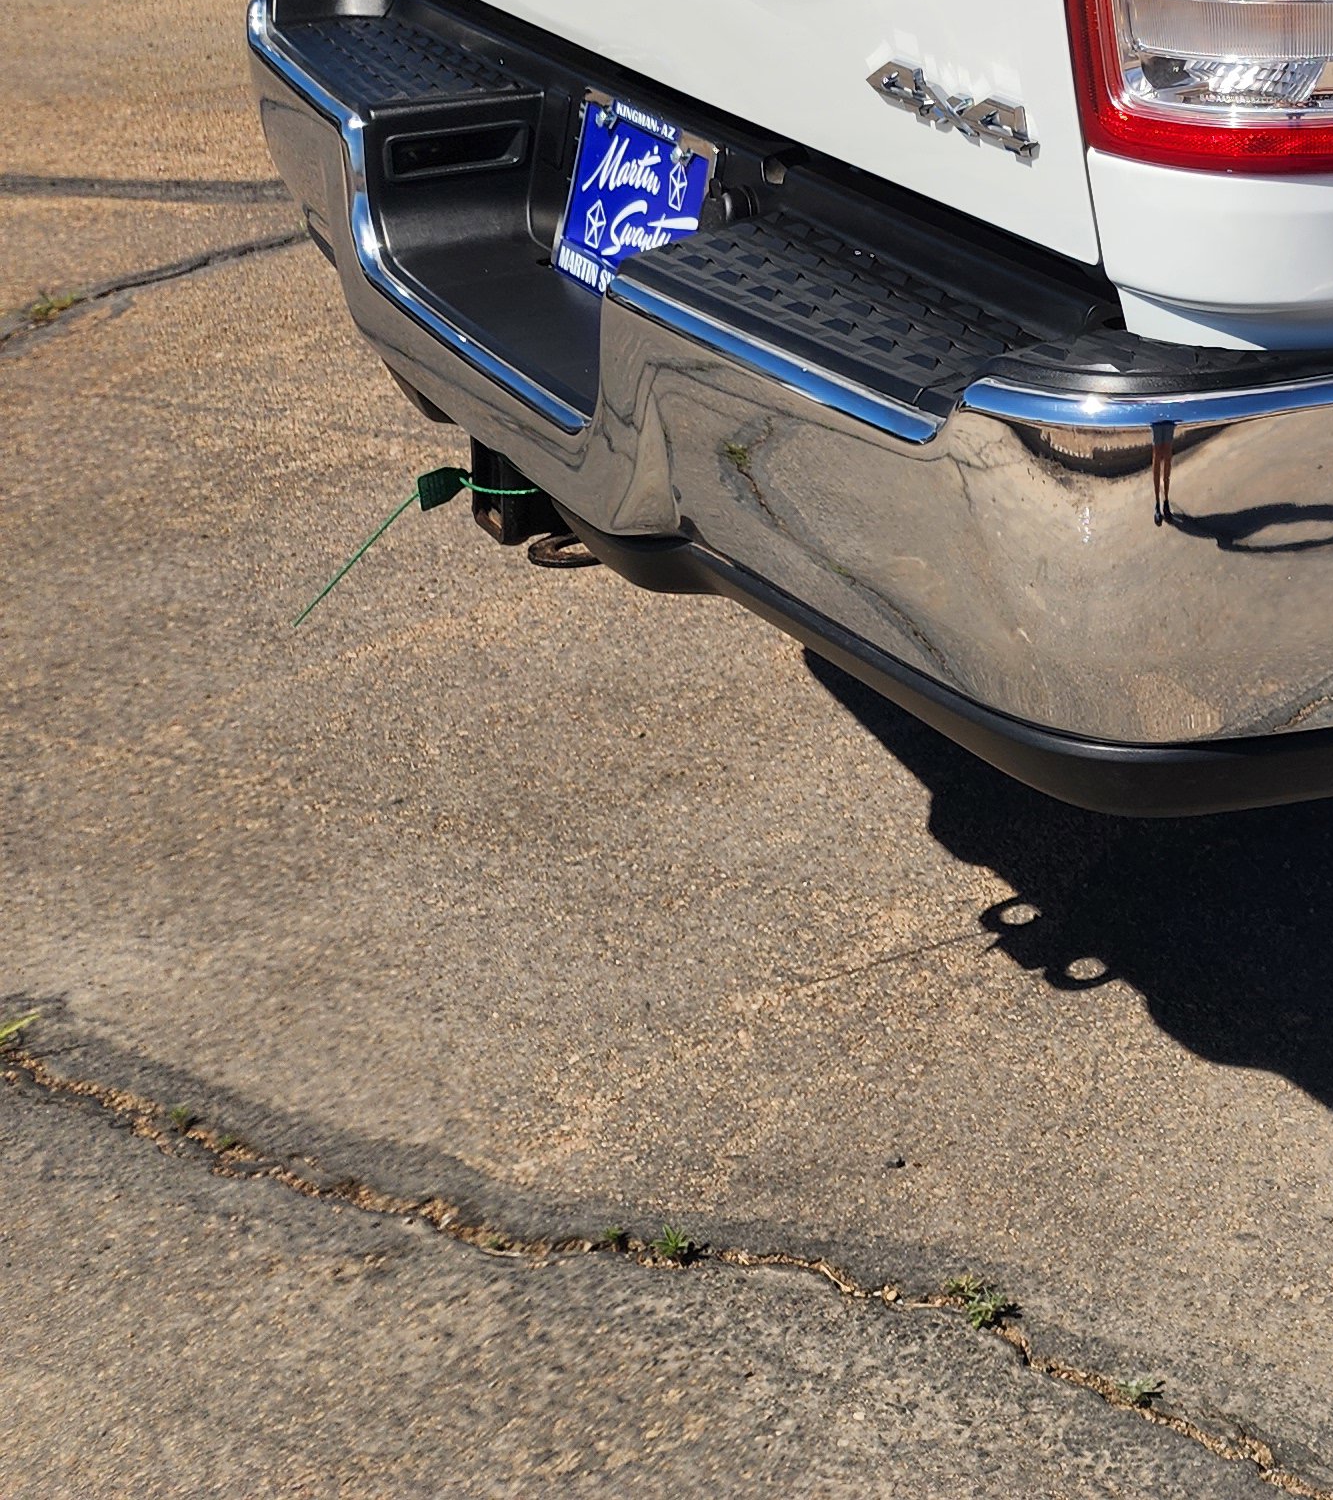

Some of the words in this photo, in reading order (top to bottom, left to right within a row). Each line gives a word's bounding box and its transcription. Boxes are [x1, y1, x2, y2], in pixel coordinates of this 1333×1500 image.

[660, 123, 676, 141] AZ
[581, 134, 662, 196] Martin
[558, 245, 600, 288] MARTIN
